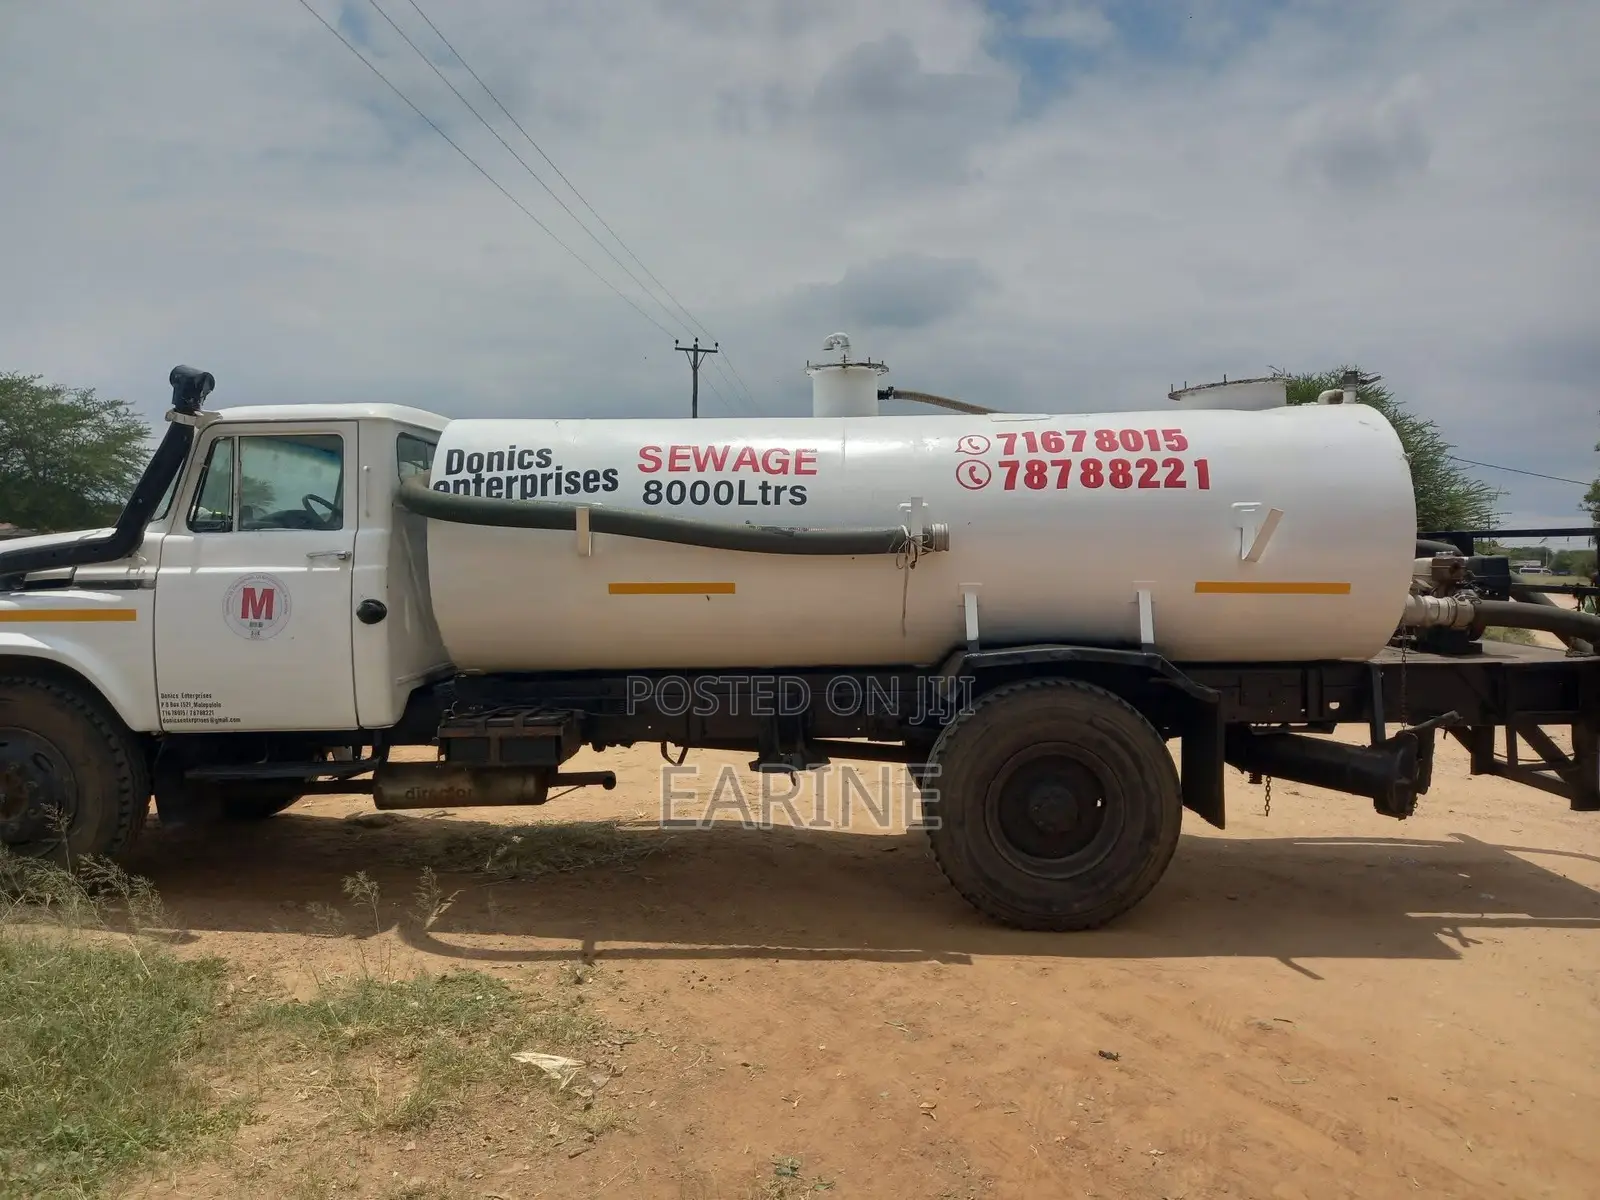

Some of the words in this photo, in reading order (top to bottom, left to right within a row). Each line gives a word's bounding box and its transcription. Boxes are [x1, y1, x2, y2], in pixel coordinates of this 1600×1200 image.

[996, 429, 1189, 455] 71678015
[445, 445, 554, 475] Donics
[637, 445, 818, 475] SEWAGE
[998, 458, 1211, 491] 78788221
[642, 480, 808, 506] 8000Ltrs
[240, 587, 275, 620] M
[181, 692, 212, 700] Enterprises
